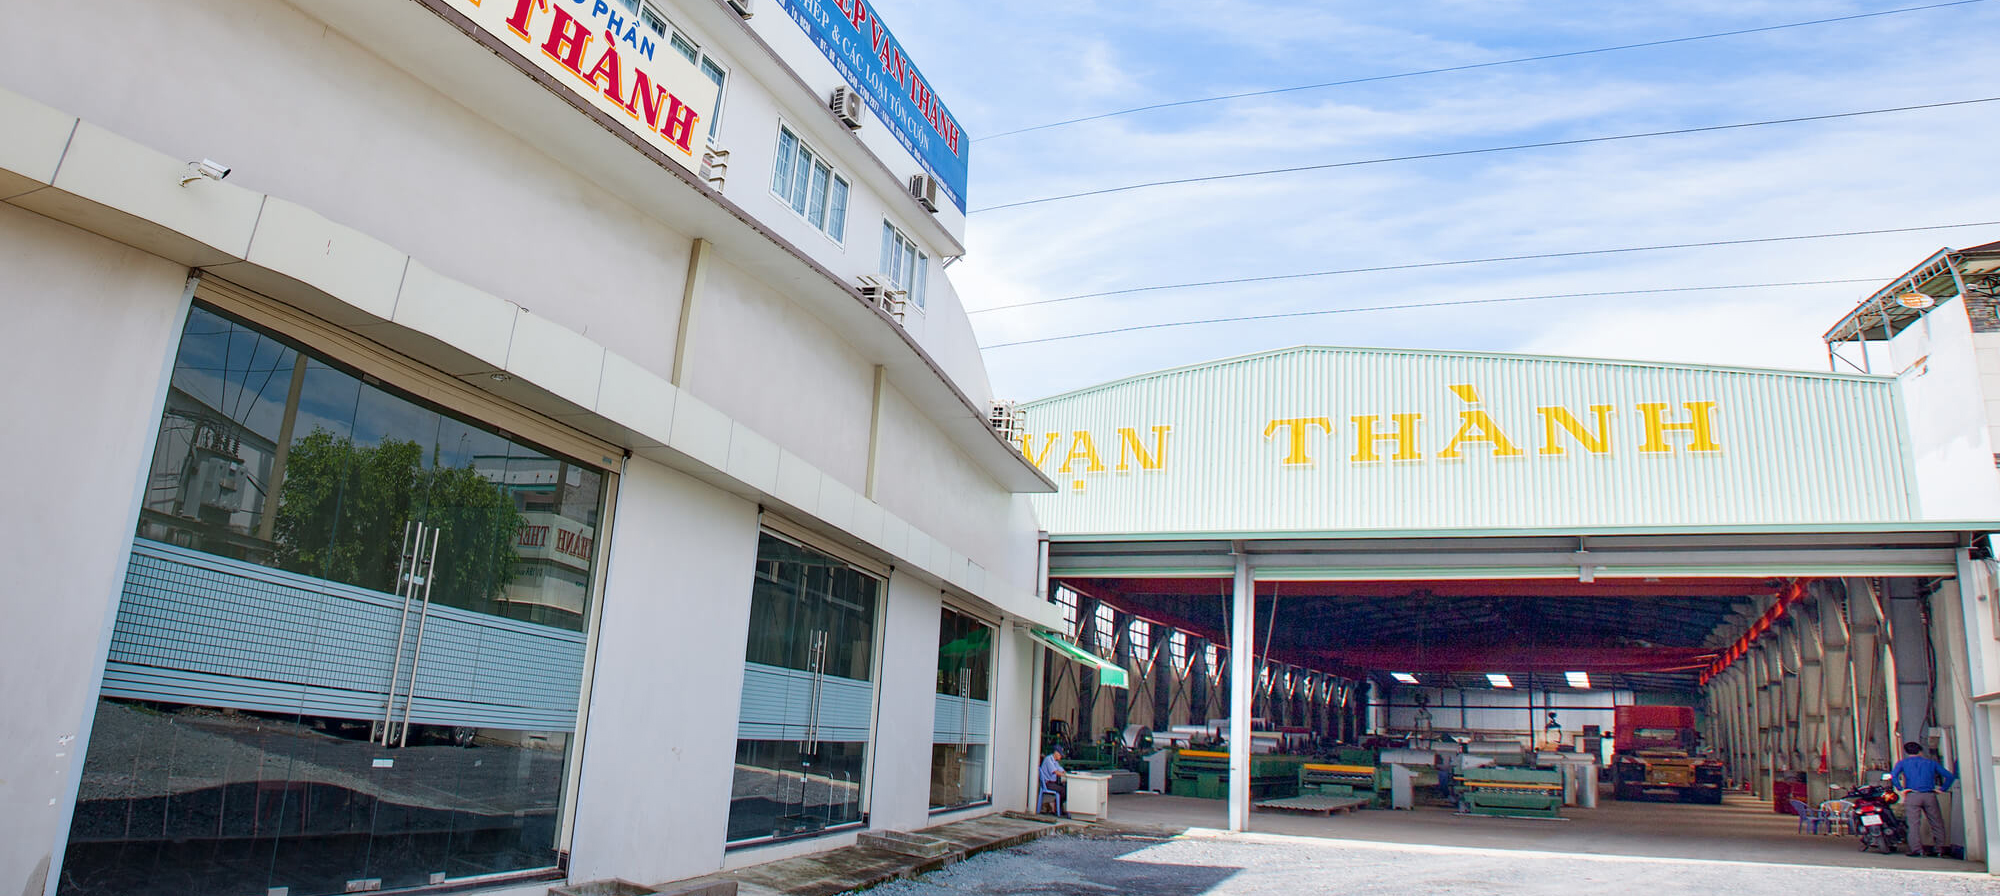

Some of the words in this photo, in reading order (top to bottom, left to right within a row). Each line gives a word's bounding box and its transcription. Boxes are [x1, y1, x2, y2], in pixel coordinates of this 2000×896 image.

[831, 25, 841, 45] &
[842, 37, 863, 71] CÁC
[865, 64, 888, 102] LOẠI
[889, 93, 906, 126] TÔN
[907, 116, 930, 151] CUỘN
[869, 14, 907, 89] VẠN
[909, 68, 960, 156] THÀNH
[1016, 425, 1172, 490] VẠN
[1265, 384, 1722, 465] THÀNH
